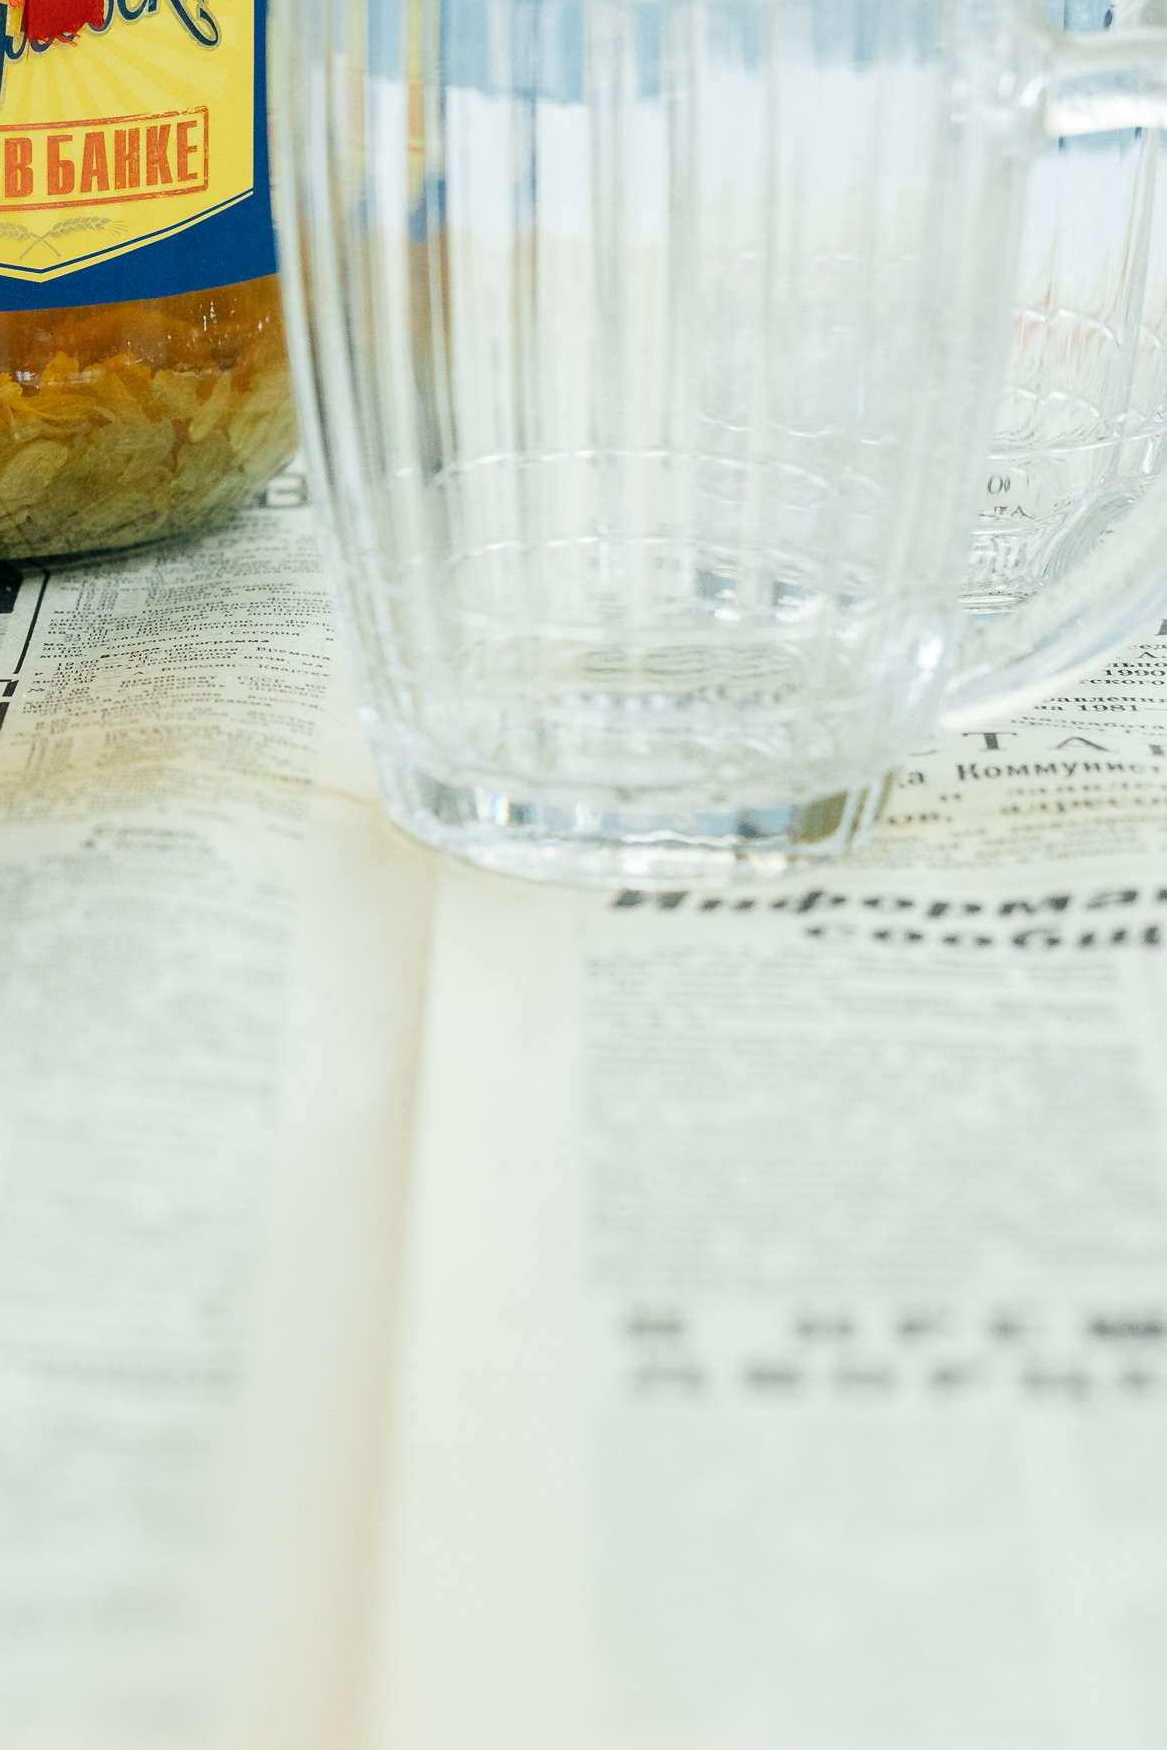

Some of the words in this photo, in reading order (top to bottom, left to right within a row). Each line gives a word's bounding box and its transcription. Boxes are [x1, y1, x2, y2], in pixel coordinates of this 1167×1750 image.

[3, 136, 34, 199] В
[46, 120, 199, 197] БАНКЕ
[1103, 669, 1166, 677] 1990
[1076, 704, 1140, 712] 1981
